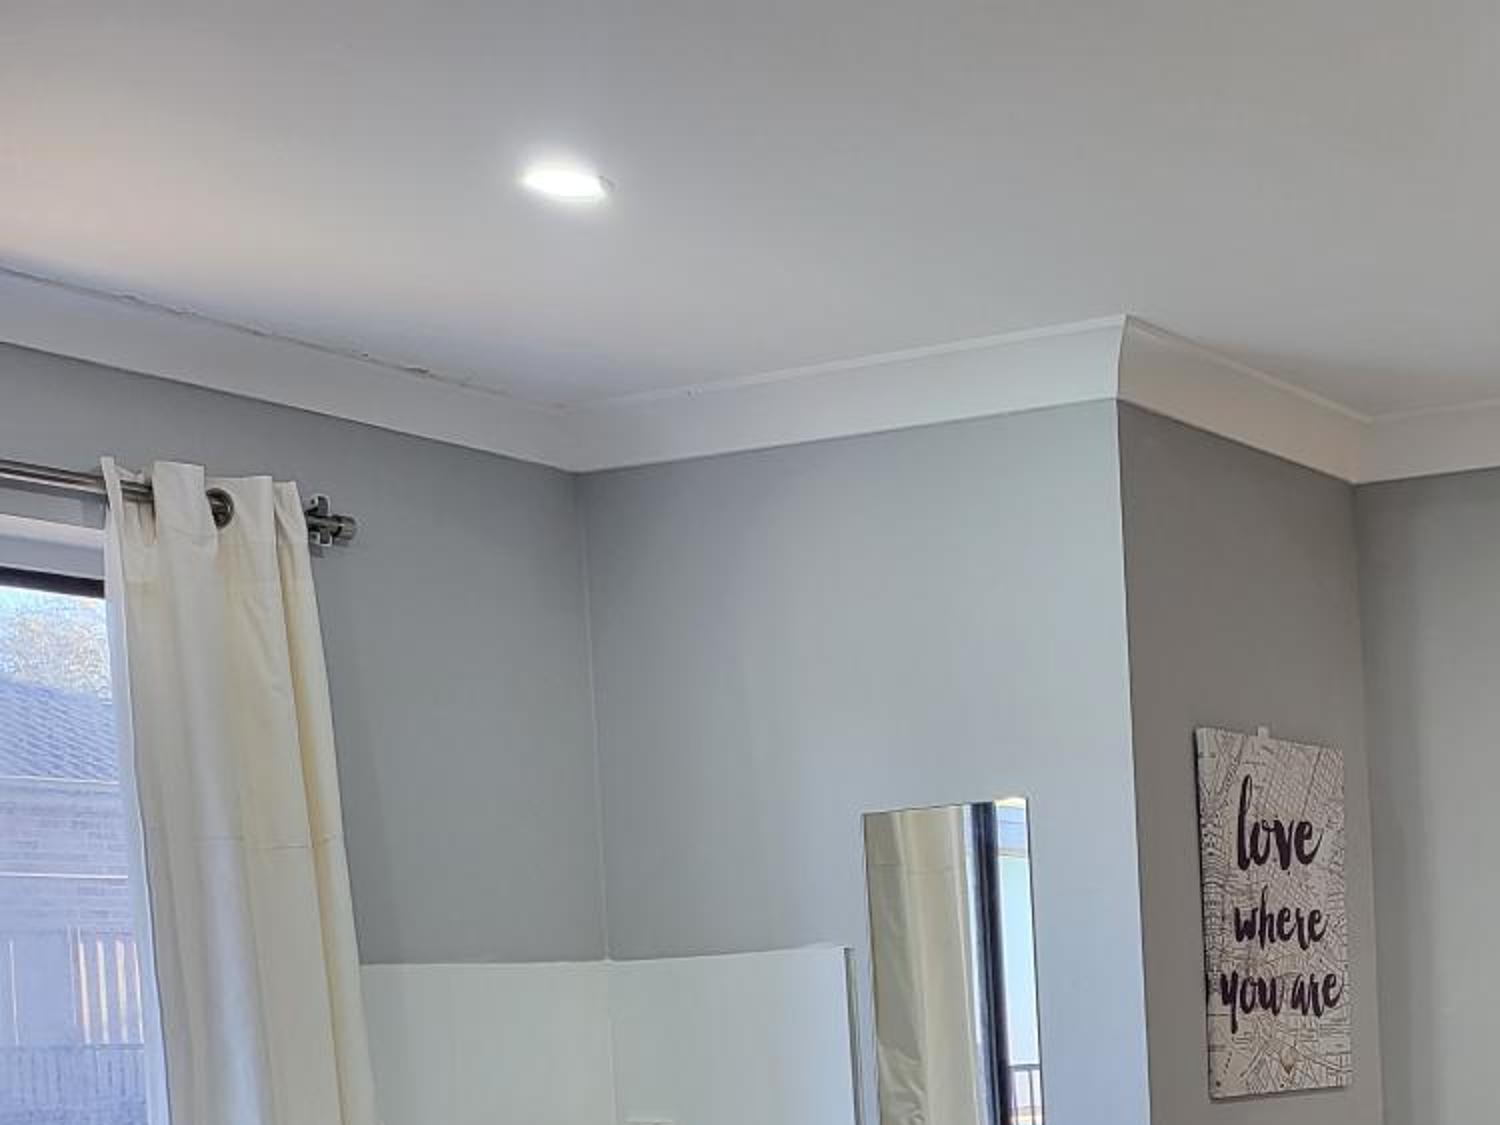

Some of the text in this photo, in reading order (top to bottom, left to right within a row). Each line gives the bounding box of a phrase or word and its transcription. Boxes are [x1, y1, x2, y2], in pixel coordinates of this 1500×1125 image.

[1236, 774, 1322, 871] love
[1233, 885, 1329, 951] where
[1219, 971, 1343, 1034] you are
